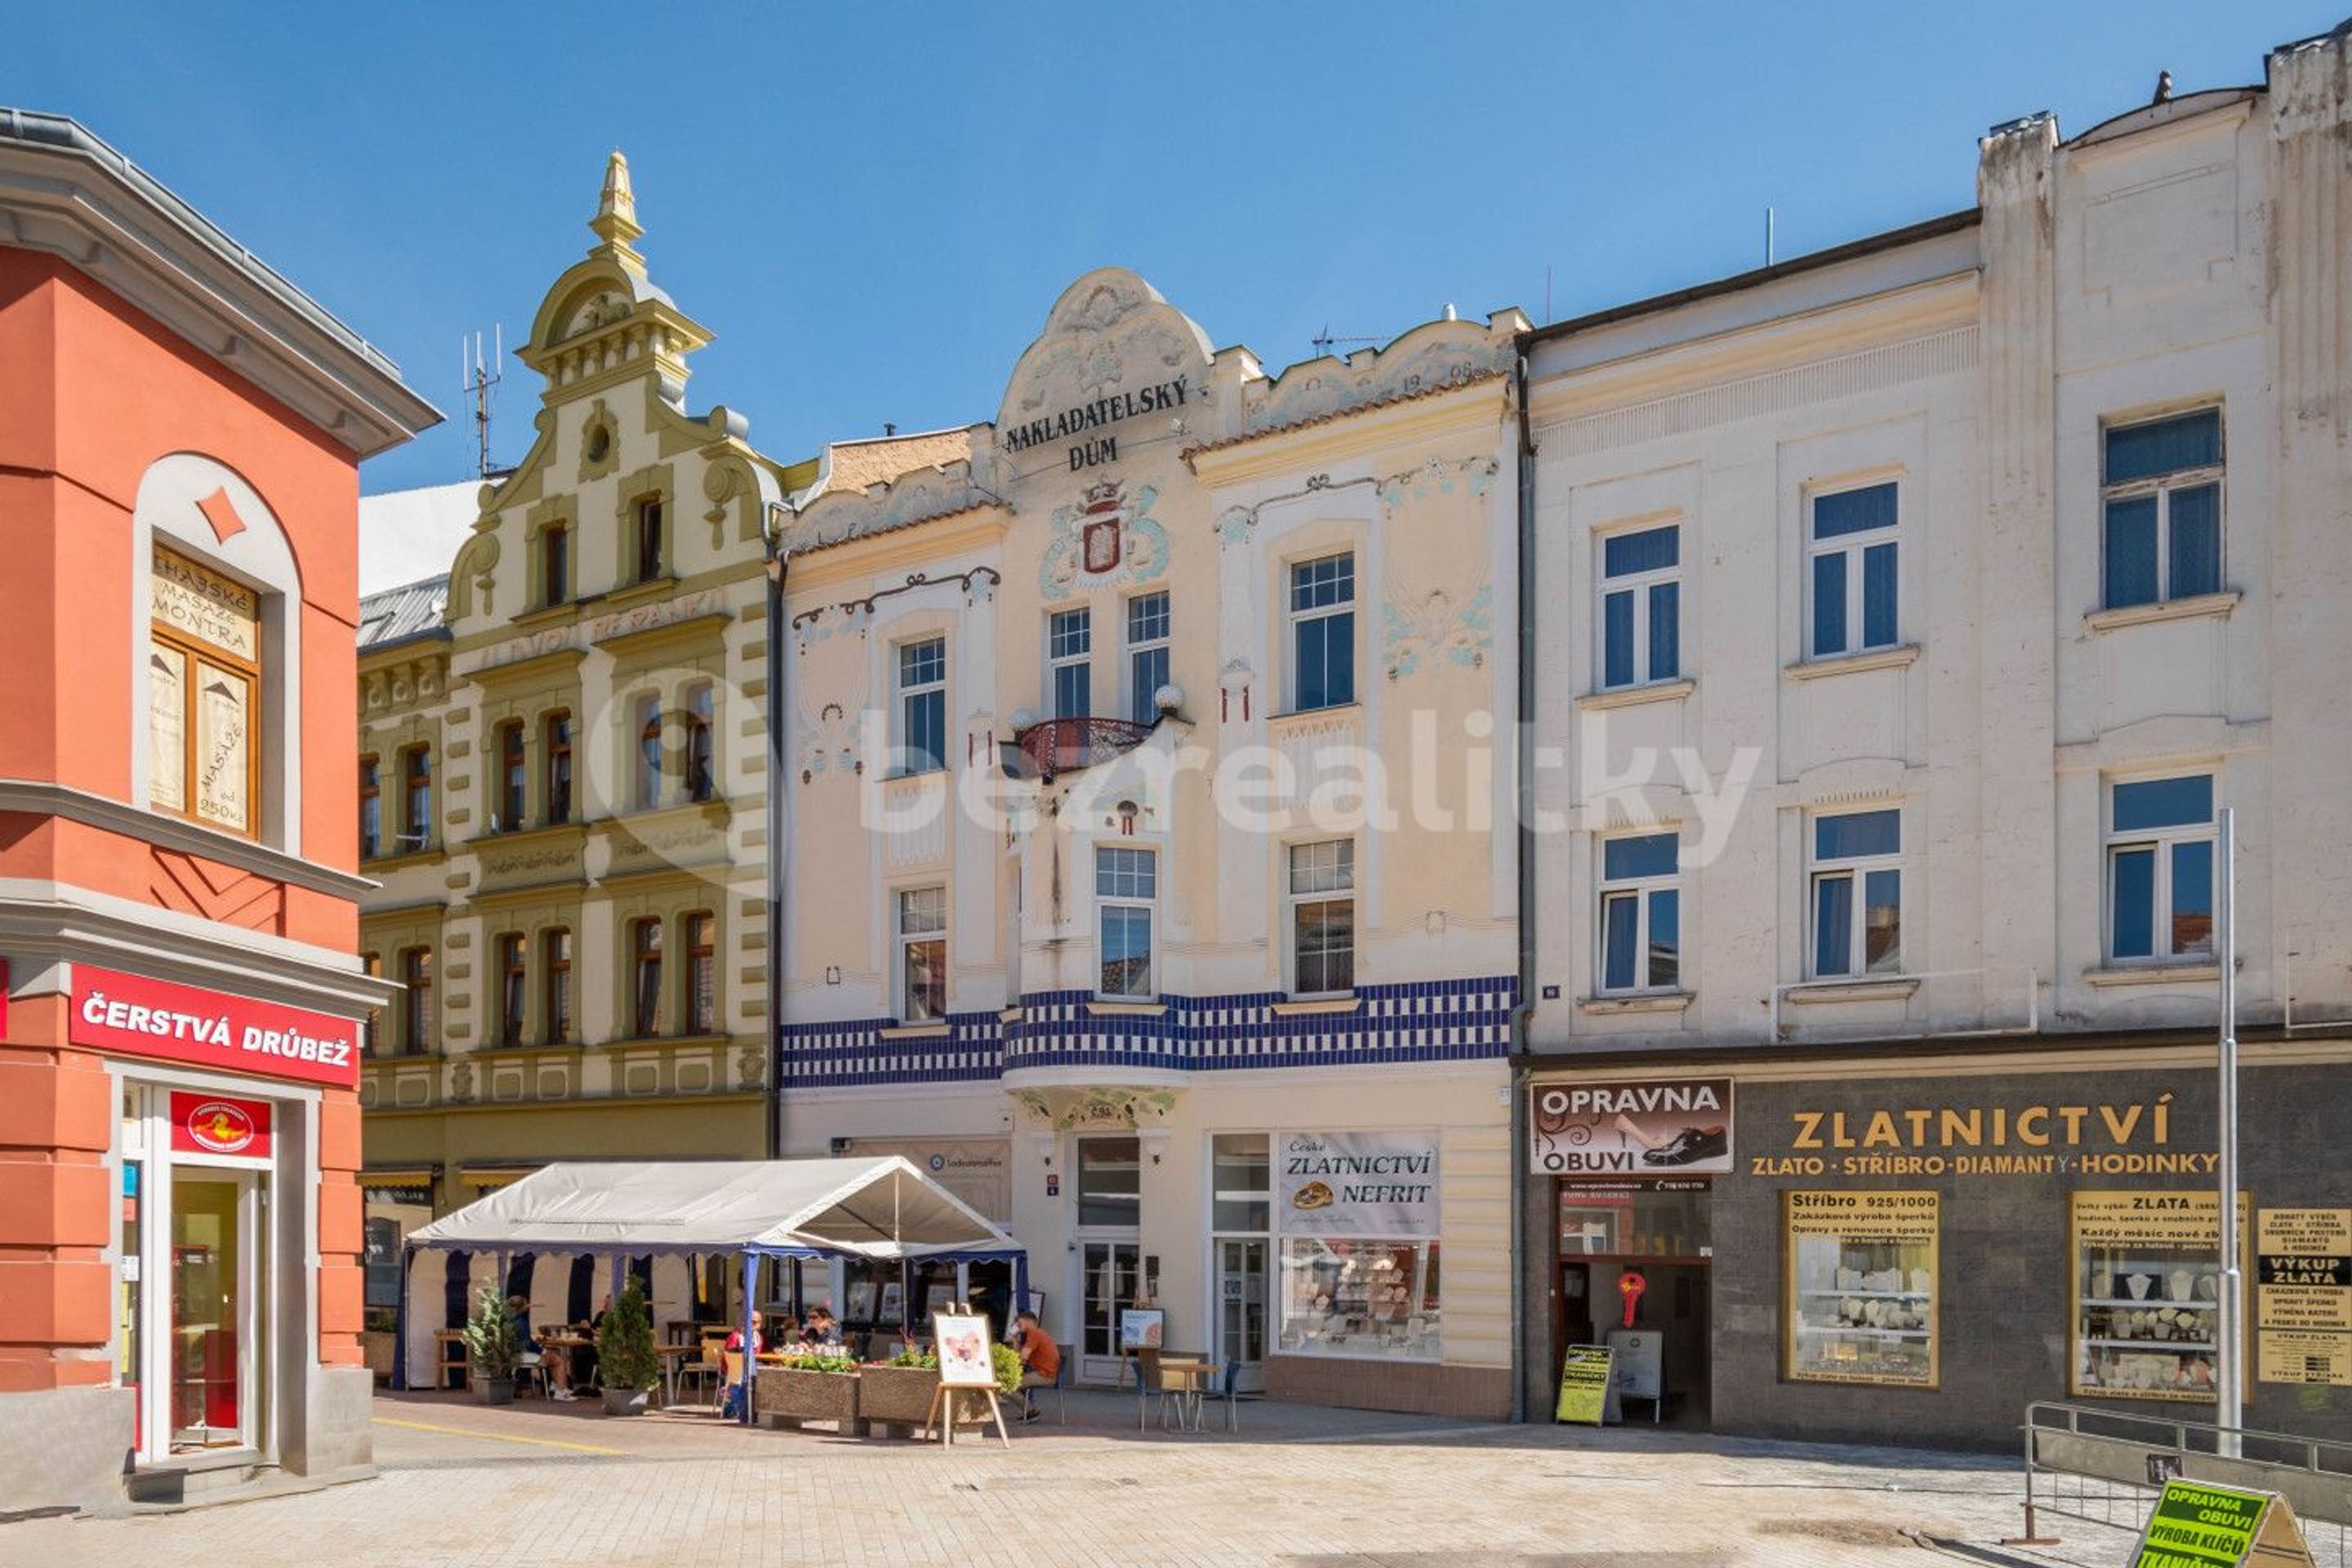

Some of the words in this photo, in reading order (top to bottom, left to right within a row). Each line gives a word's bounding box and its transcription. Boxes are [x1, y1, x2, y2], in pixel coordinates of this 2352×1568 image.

[1005, 374, 1188, 454] NAKLADATELSKÝ
[1069, 435, 1118, 471] DŮM
[82, 991, 231, 1047] ČERSTVÁ
[242, 1027, 351, 1067] DRŮBEŽ
[1541, 1086, 1721, 1115] OPRAVNA
[1792, 1092, 2174, 1149] ZLATNICTVÍ
[1287, 1151, 1431, 1175] ZLATNICTVÍ
[1543, 1152, 1633, 1171] OBUVI
[1751, 1156, 1825, 1176] ZLATO
[1843, 1152, 1945, 1175] STŘÍBRO
[1955, 1154, 2069, 1174] DIAMANTY
[2081, 1152, 2221, 1174] HODINKY
[1342, 1185, 1432, 1204] NEFRIT
[1792, 1194, 1857, 1207] Stříbro
[1866, 1196, 1936, 1208] 925/1000
[2132, 1197, 2190, 1210] ZLATA
[1854, 1212, 1892, 1222] výroba
[1792, 1225, 1829, 1235] Opravy
[2080, 1228, 2120, 1238] Každý
[2124, 1228, 2163, 1238] měsíc
[2167, 1228, 2200, 1238] nové
[2271, 1256, 2341, 1271] VÝKUP
[2274, 1272, 2336, 1284] ZLATA
[2167, 1489, 2242, 1512] OPRAVNA
[2198, 1509, 2252, 1529] OBUVI
[2149, 1523, 2198, 1547] VÝROBA
[2199, 1531, 2246, 1556] KLÍČŮ
